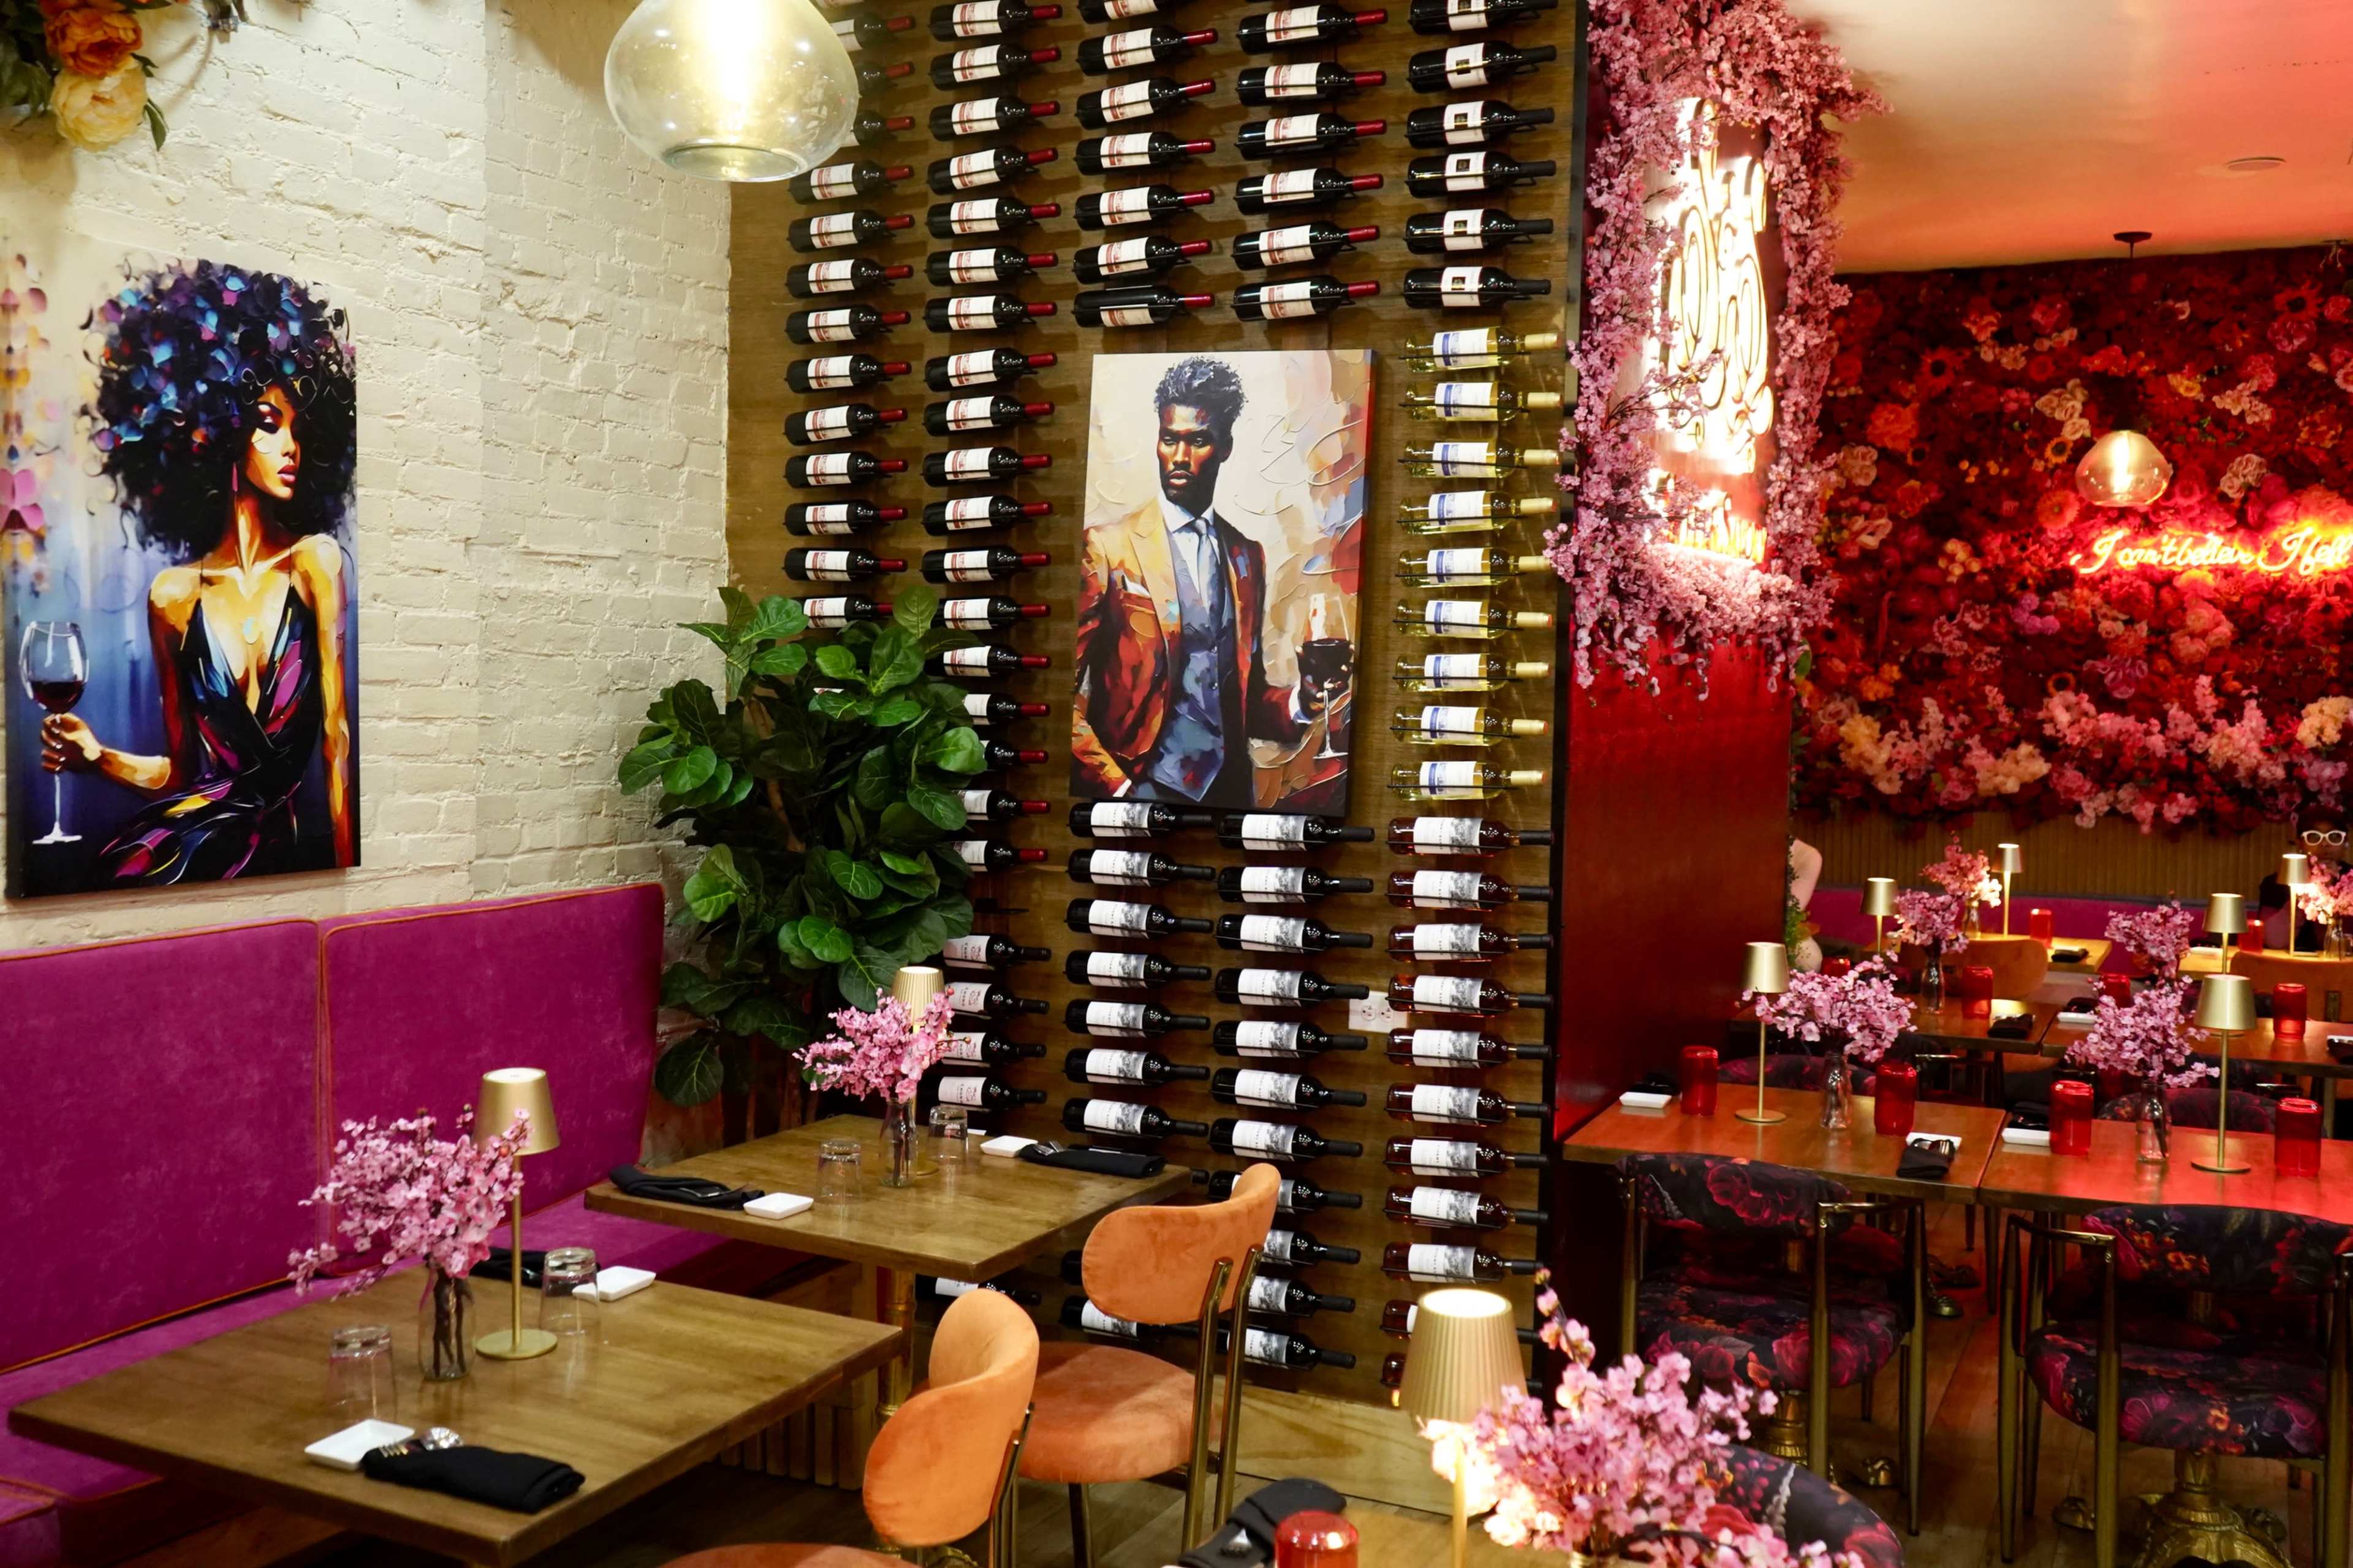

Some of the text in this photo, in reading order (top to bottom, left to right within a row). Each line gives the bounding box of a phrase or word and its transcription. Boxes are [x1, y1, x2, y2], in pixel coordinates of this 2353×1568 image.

[2069, 529, 2124, 574] I
[2118, 534, 2177, 566] can't
[2177, 532, 2255, 566] believe
[2257, 526, 2314, 571] I
